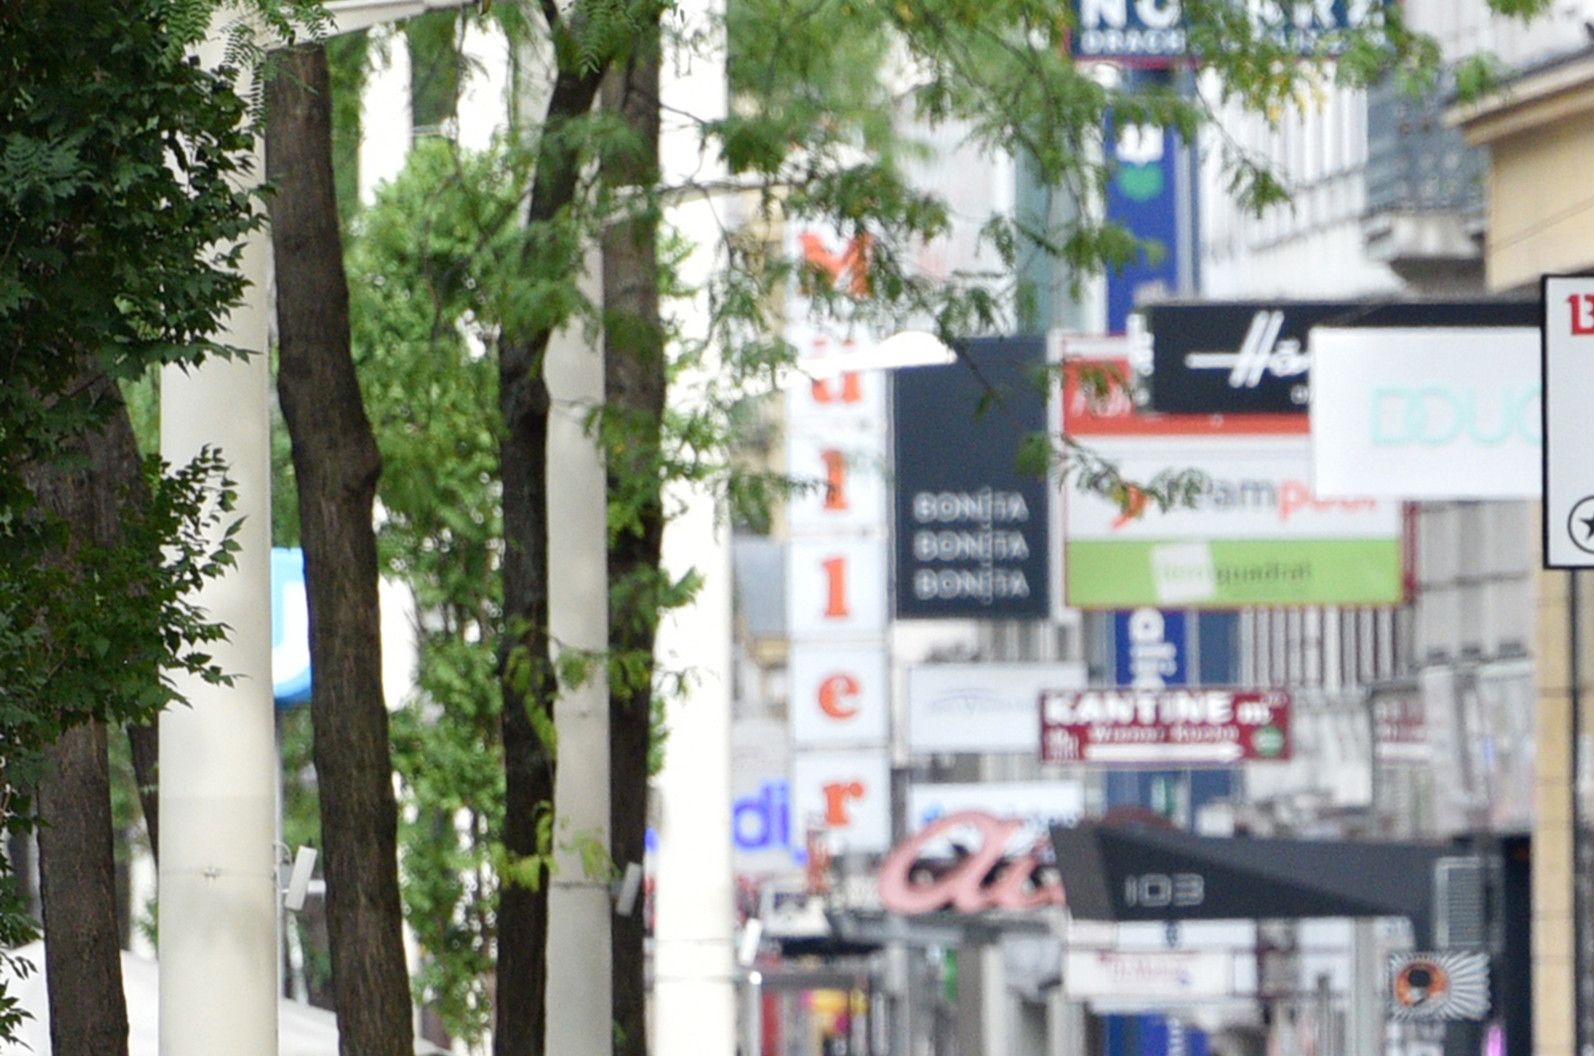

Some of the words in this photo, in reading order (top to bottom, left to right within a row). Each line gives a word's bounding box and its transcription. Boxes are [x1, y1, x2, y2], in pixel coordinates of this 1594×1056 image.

[912, 490, 1031, 524] BONITA
[912, 529, 1031, 562] BONITA
[912, 567, 1031, 600] BONITA
[1043, 691, 1236, 725] KANTINE
[1124, 873, 1204, 907] 103
